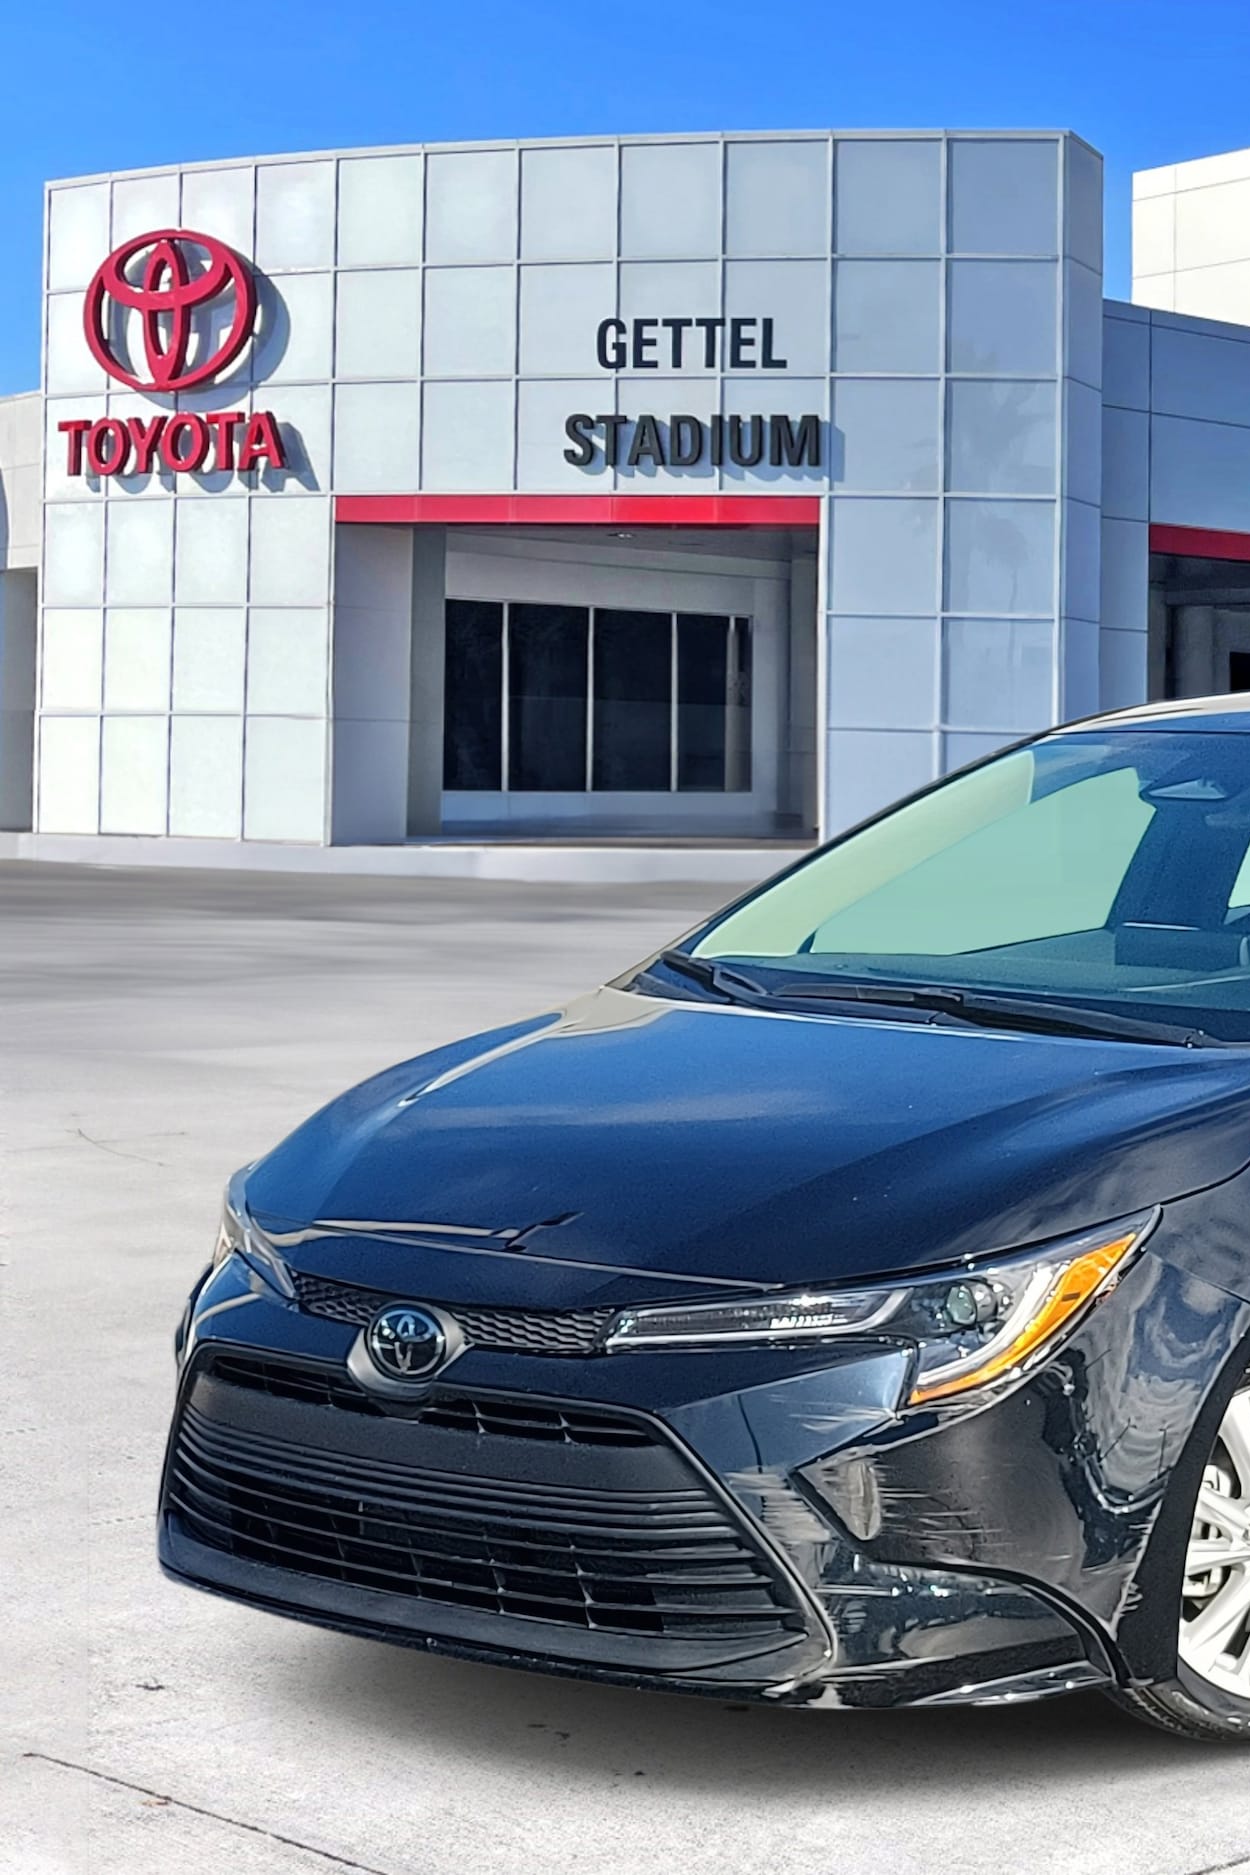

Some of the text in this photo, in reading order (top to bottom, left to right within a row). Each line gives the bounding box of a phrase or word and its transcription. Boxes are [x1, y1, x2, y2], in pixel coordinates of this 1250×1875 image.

[597, 318, 787, 369] GETTEL
[58, 411, 287, 476] TOYOTA
[563, 413, 820, 467] STADIUM
